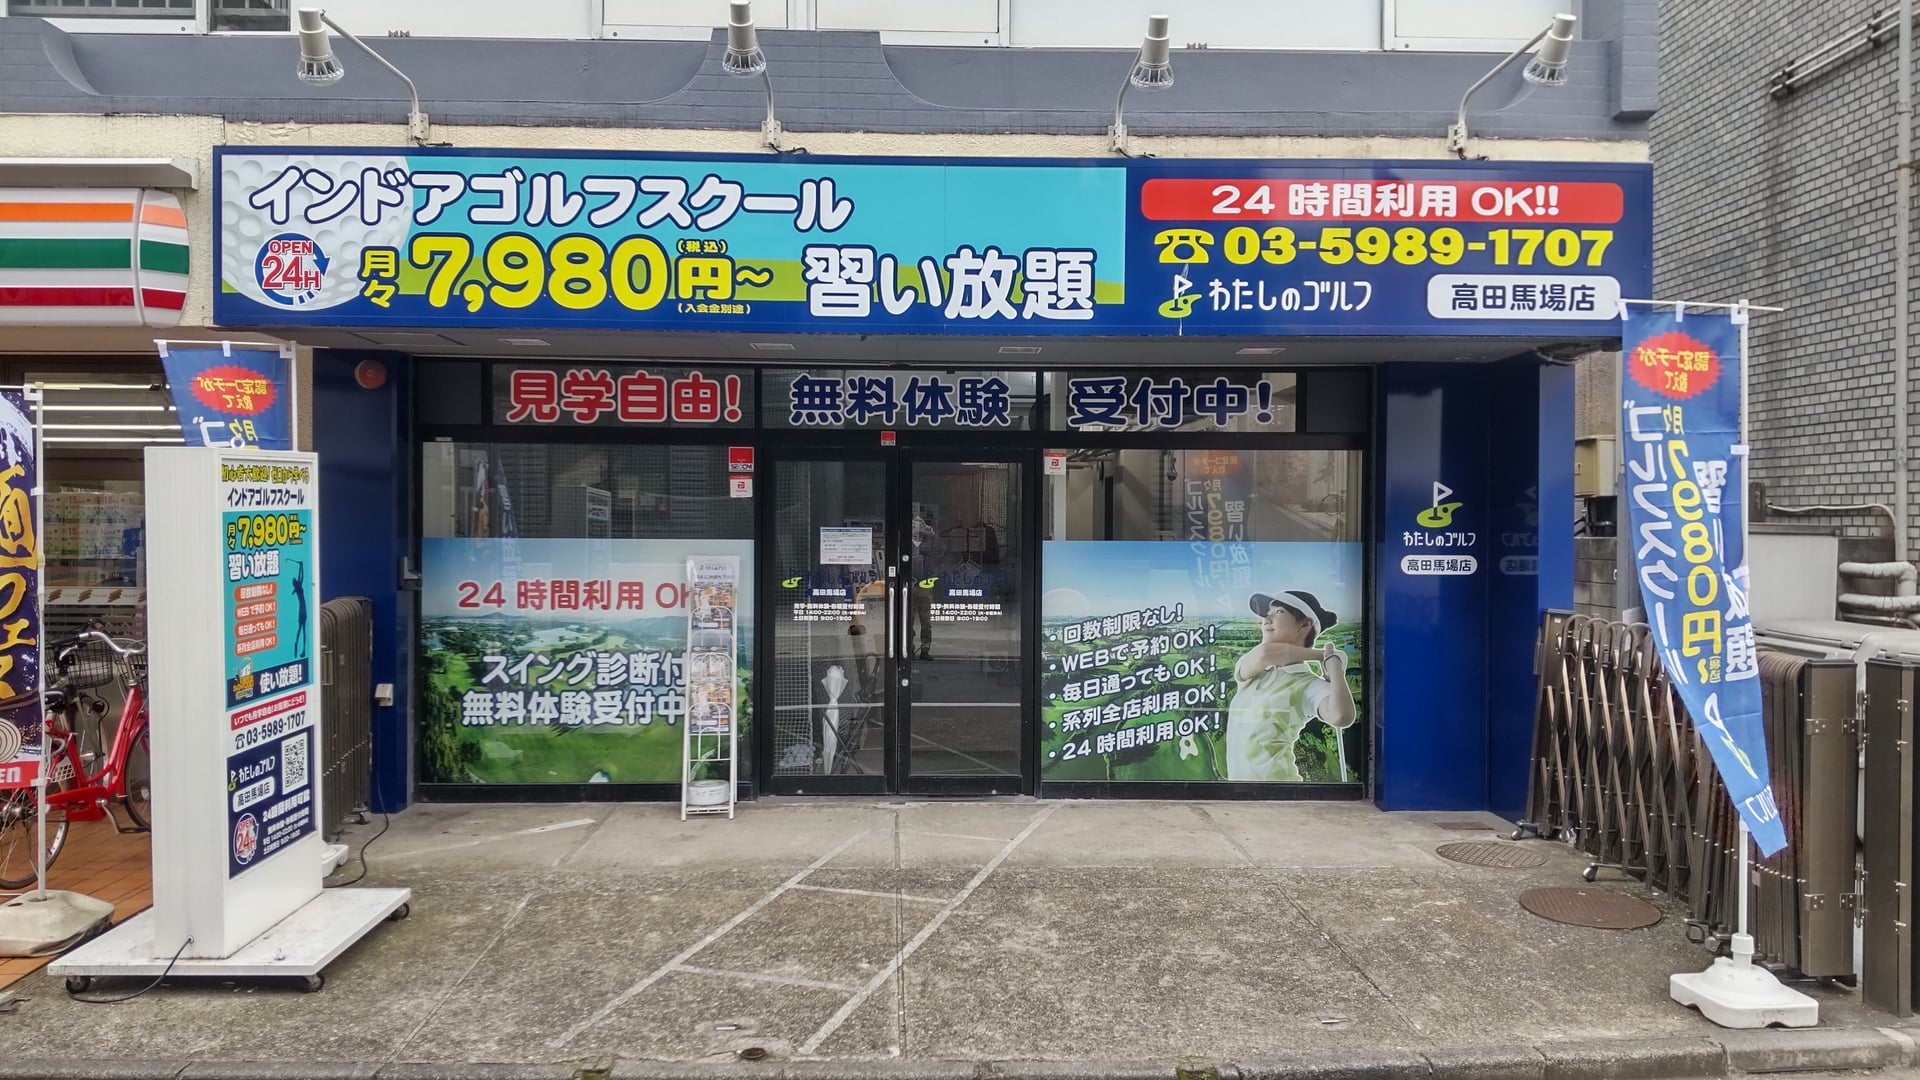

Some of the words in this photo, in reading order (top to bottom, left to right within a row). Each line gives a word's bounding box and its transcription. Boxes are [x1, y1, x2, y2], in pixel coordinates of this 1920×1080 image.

[250, 166, 854, 232] インドアゴルフスクール
[1211, 185, 1275, 215] 24
[1288, 184, 1457, 218] 時間利用
[1471, 185, 1560, 217] OK!!
[269, 241, 313, 254] OPEN
[1223, 226, 1614, 266] 03-5989-1707
[263, 255, 320, 289] 24H
[361, 246, 398, 309] 月々
[802, 243, 1097, 321] 習い放題
[1208, 278, 1372, 312] わたしのゴルフ
[1451, 283, 1596, 312] 高田馬場店
[507, 369, 742, 424] 見学自由!
[789, 373, 1012, 427] 無料体験
[1068, 376, 1274, 428] 受付中!
[227, 487, 304, 507] インドアゴルフスクール
[1402, 531, 1476, 547] わたしのゴルフ
[228, 549, 279, 582] 習い放題
[1407, 559, 1472, 572] 高田馬場店
[457, 581, 507, 609] 24
[516, 579, 645, 610] 時間利用
[1062, 602, 1184, 644] 回数制限なし!
[461, 689, 687, 727] 無料体験受付中
[246, 710, 305, 745] 03-5989-1707
[239, 756, 275, 783] わたしのゴルフ
[238, 782, 270, 808] 高田馬場店
